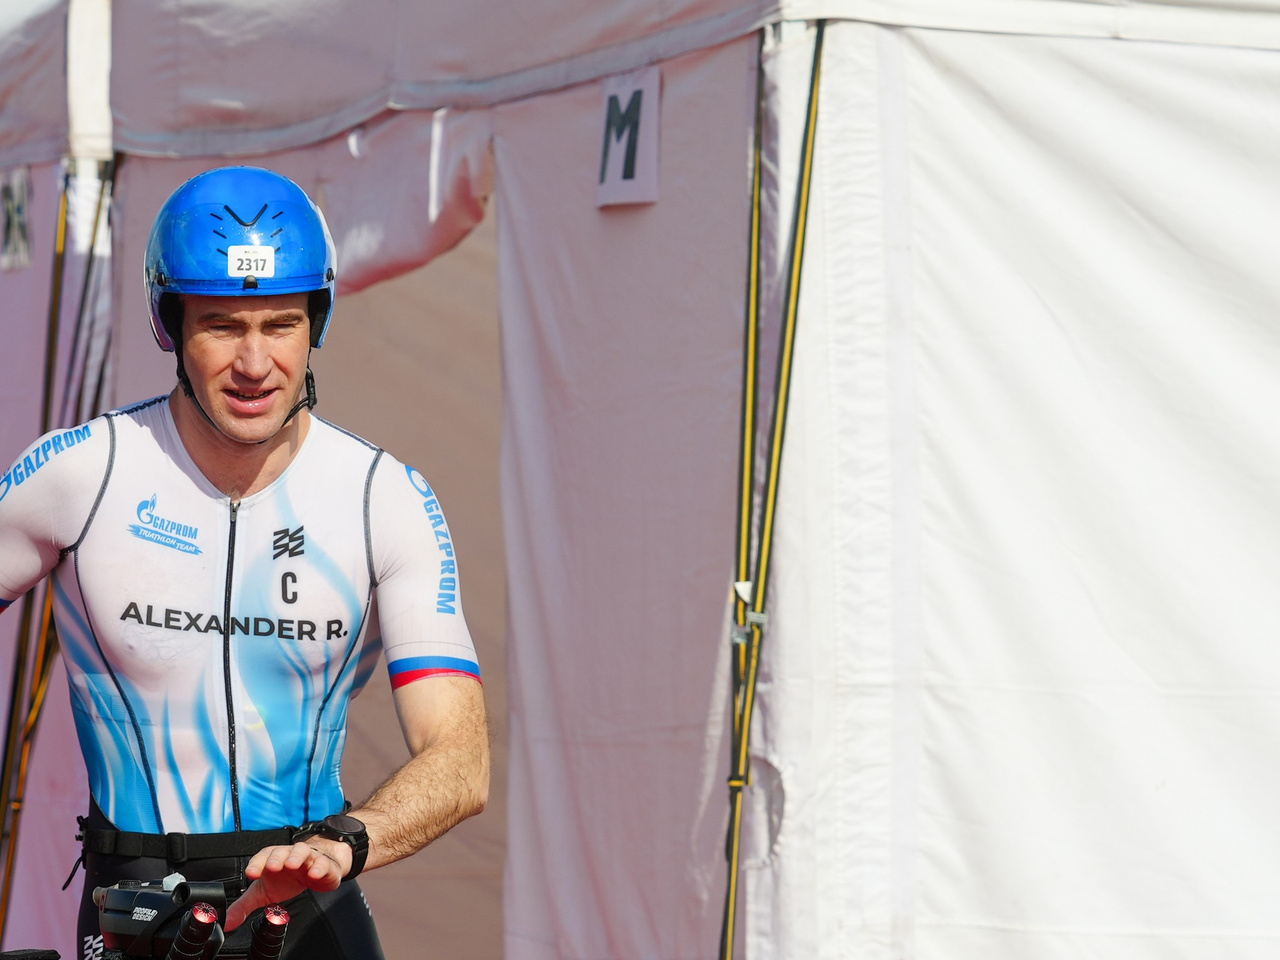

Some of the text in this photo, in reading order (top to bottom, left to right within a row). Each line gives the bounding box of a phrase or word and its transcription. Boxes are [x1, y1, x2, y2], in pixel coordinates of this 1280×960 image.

[236, 258, 267, 271] 2317
[12, 424, 92, 486] GAZPROM
[139, 529, 196, 552] TRIATHLON TEAM
[152, 515, 199, 540] GAZPROM
[423, 498, 456, 615] GAZPROM
[281, 571, 298, 604] C
[120, 601, 348, 641] ALEXANDER R.
